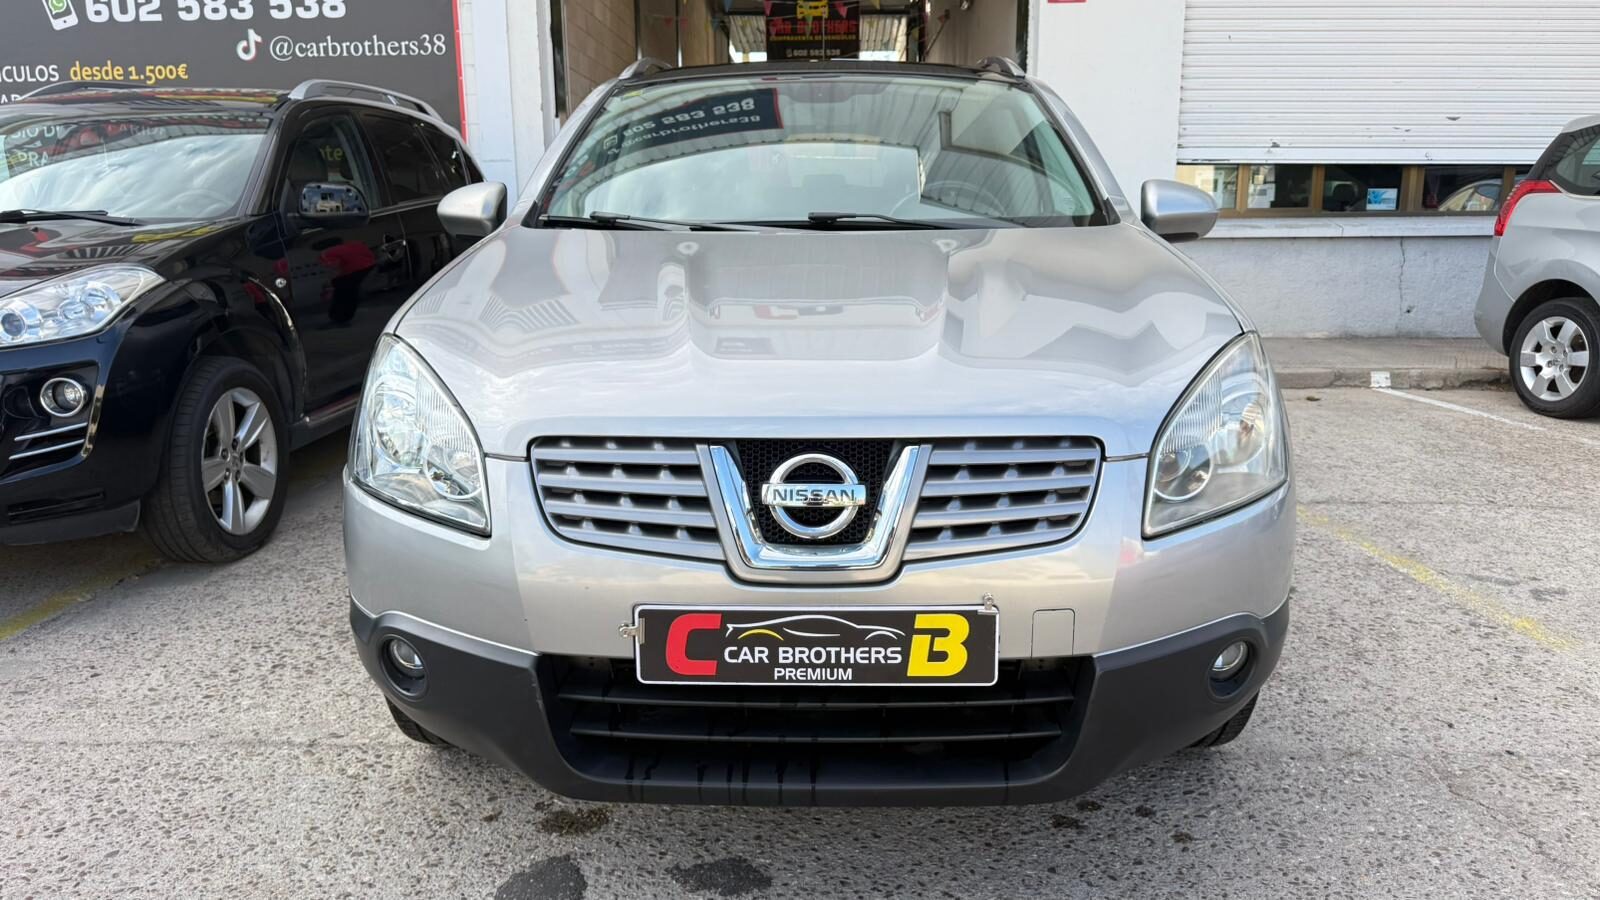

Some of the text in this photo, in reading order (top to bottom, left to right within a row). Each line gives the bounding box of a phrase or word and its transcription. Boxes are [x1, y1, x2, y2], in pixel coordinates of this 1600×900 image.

[86, 0, 346, 22] 602 583 538
[269, 33, 447, 62] @carbrothers38
[70, 61, 124, 81] desde
[129, 64, 189, 84] 1.500€
[772, 488, 856, 502] NISSAN
[665, 612, 722, 676] C
[724, 646, 903, 664] CAR BROTHERS
[774, 667, 853, 681] PREMIUM
